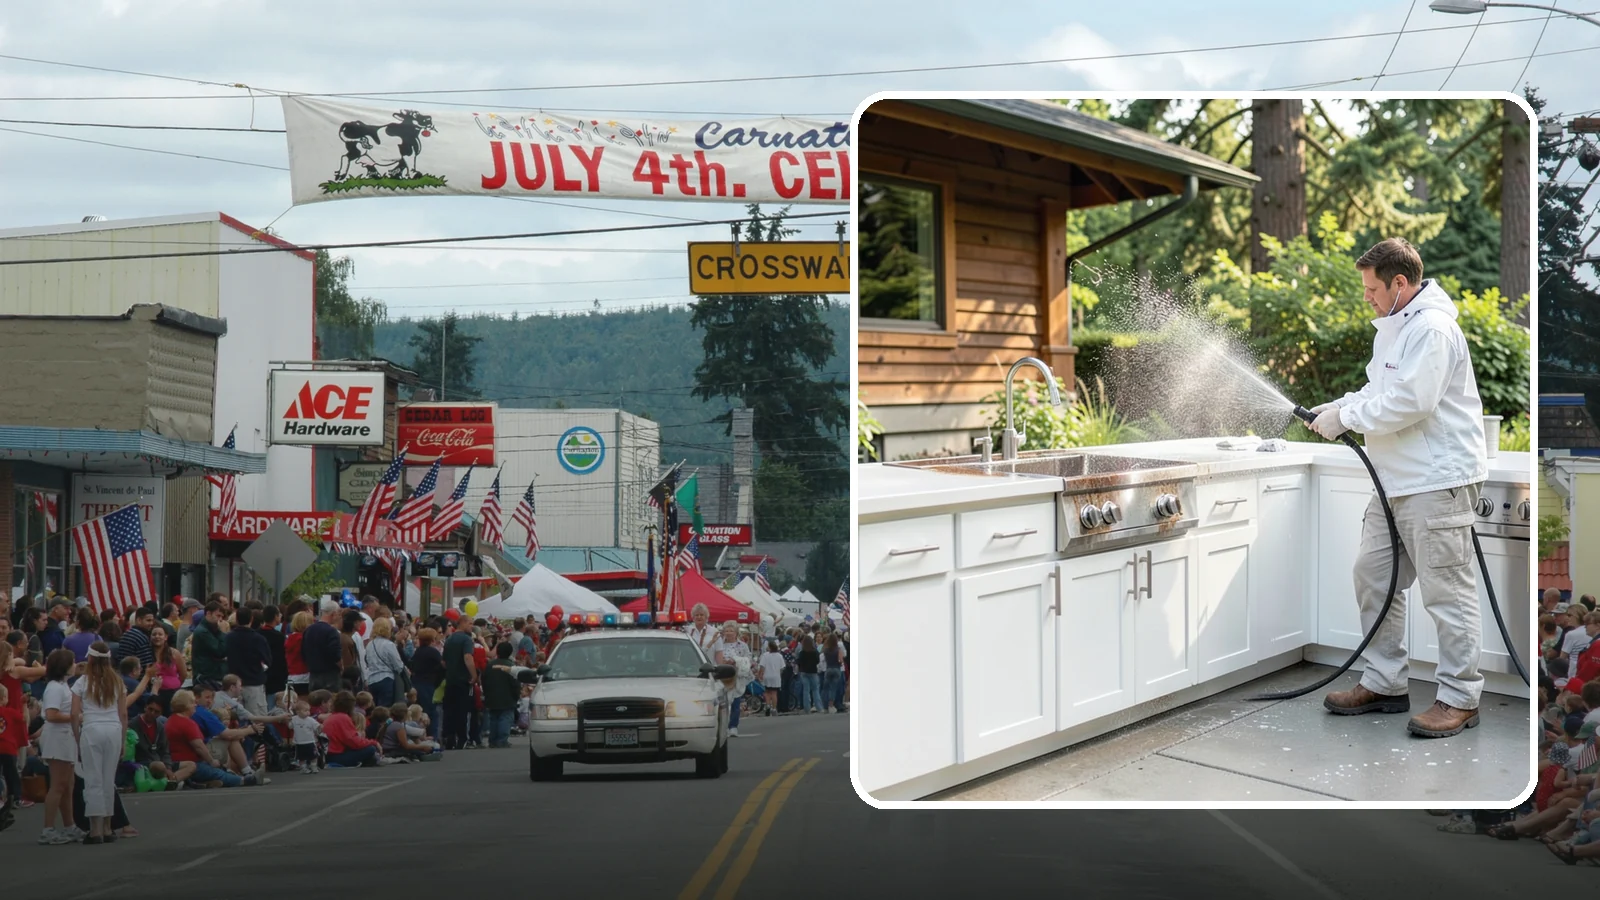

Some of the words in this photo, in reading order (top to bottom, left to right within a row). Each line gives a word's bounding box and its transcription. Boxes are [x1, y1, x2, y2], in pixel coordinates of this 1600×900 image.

[481, 141, 605, 193] JULY
[632, 150, 746, 197] 4th.
[697, 254, 850, 280] CROSSWA
[283, 380, 374, 420] ACE
[405, 409, 452, 422] CEDAR
[461, 409, 485, 421] LOG
[283, 421, 371, 436] Hardware
[416, 428, 477, 447] Coca-Cola
[83, 485, 94, 494] St.
[96, 485, 124, 494] Vincent
[126, 486, 136, 495] de
[137, 486, 155, 495] Paul
[81, 503, 153, 522] THT
[212, 516, 331, 535] HARDARE
[688, 526, 741, 535] CRNATION
[699, 535, 730, 543] GLASS
